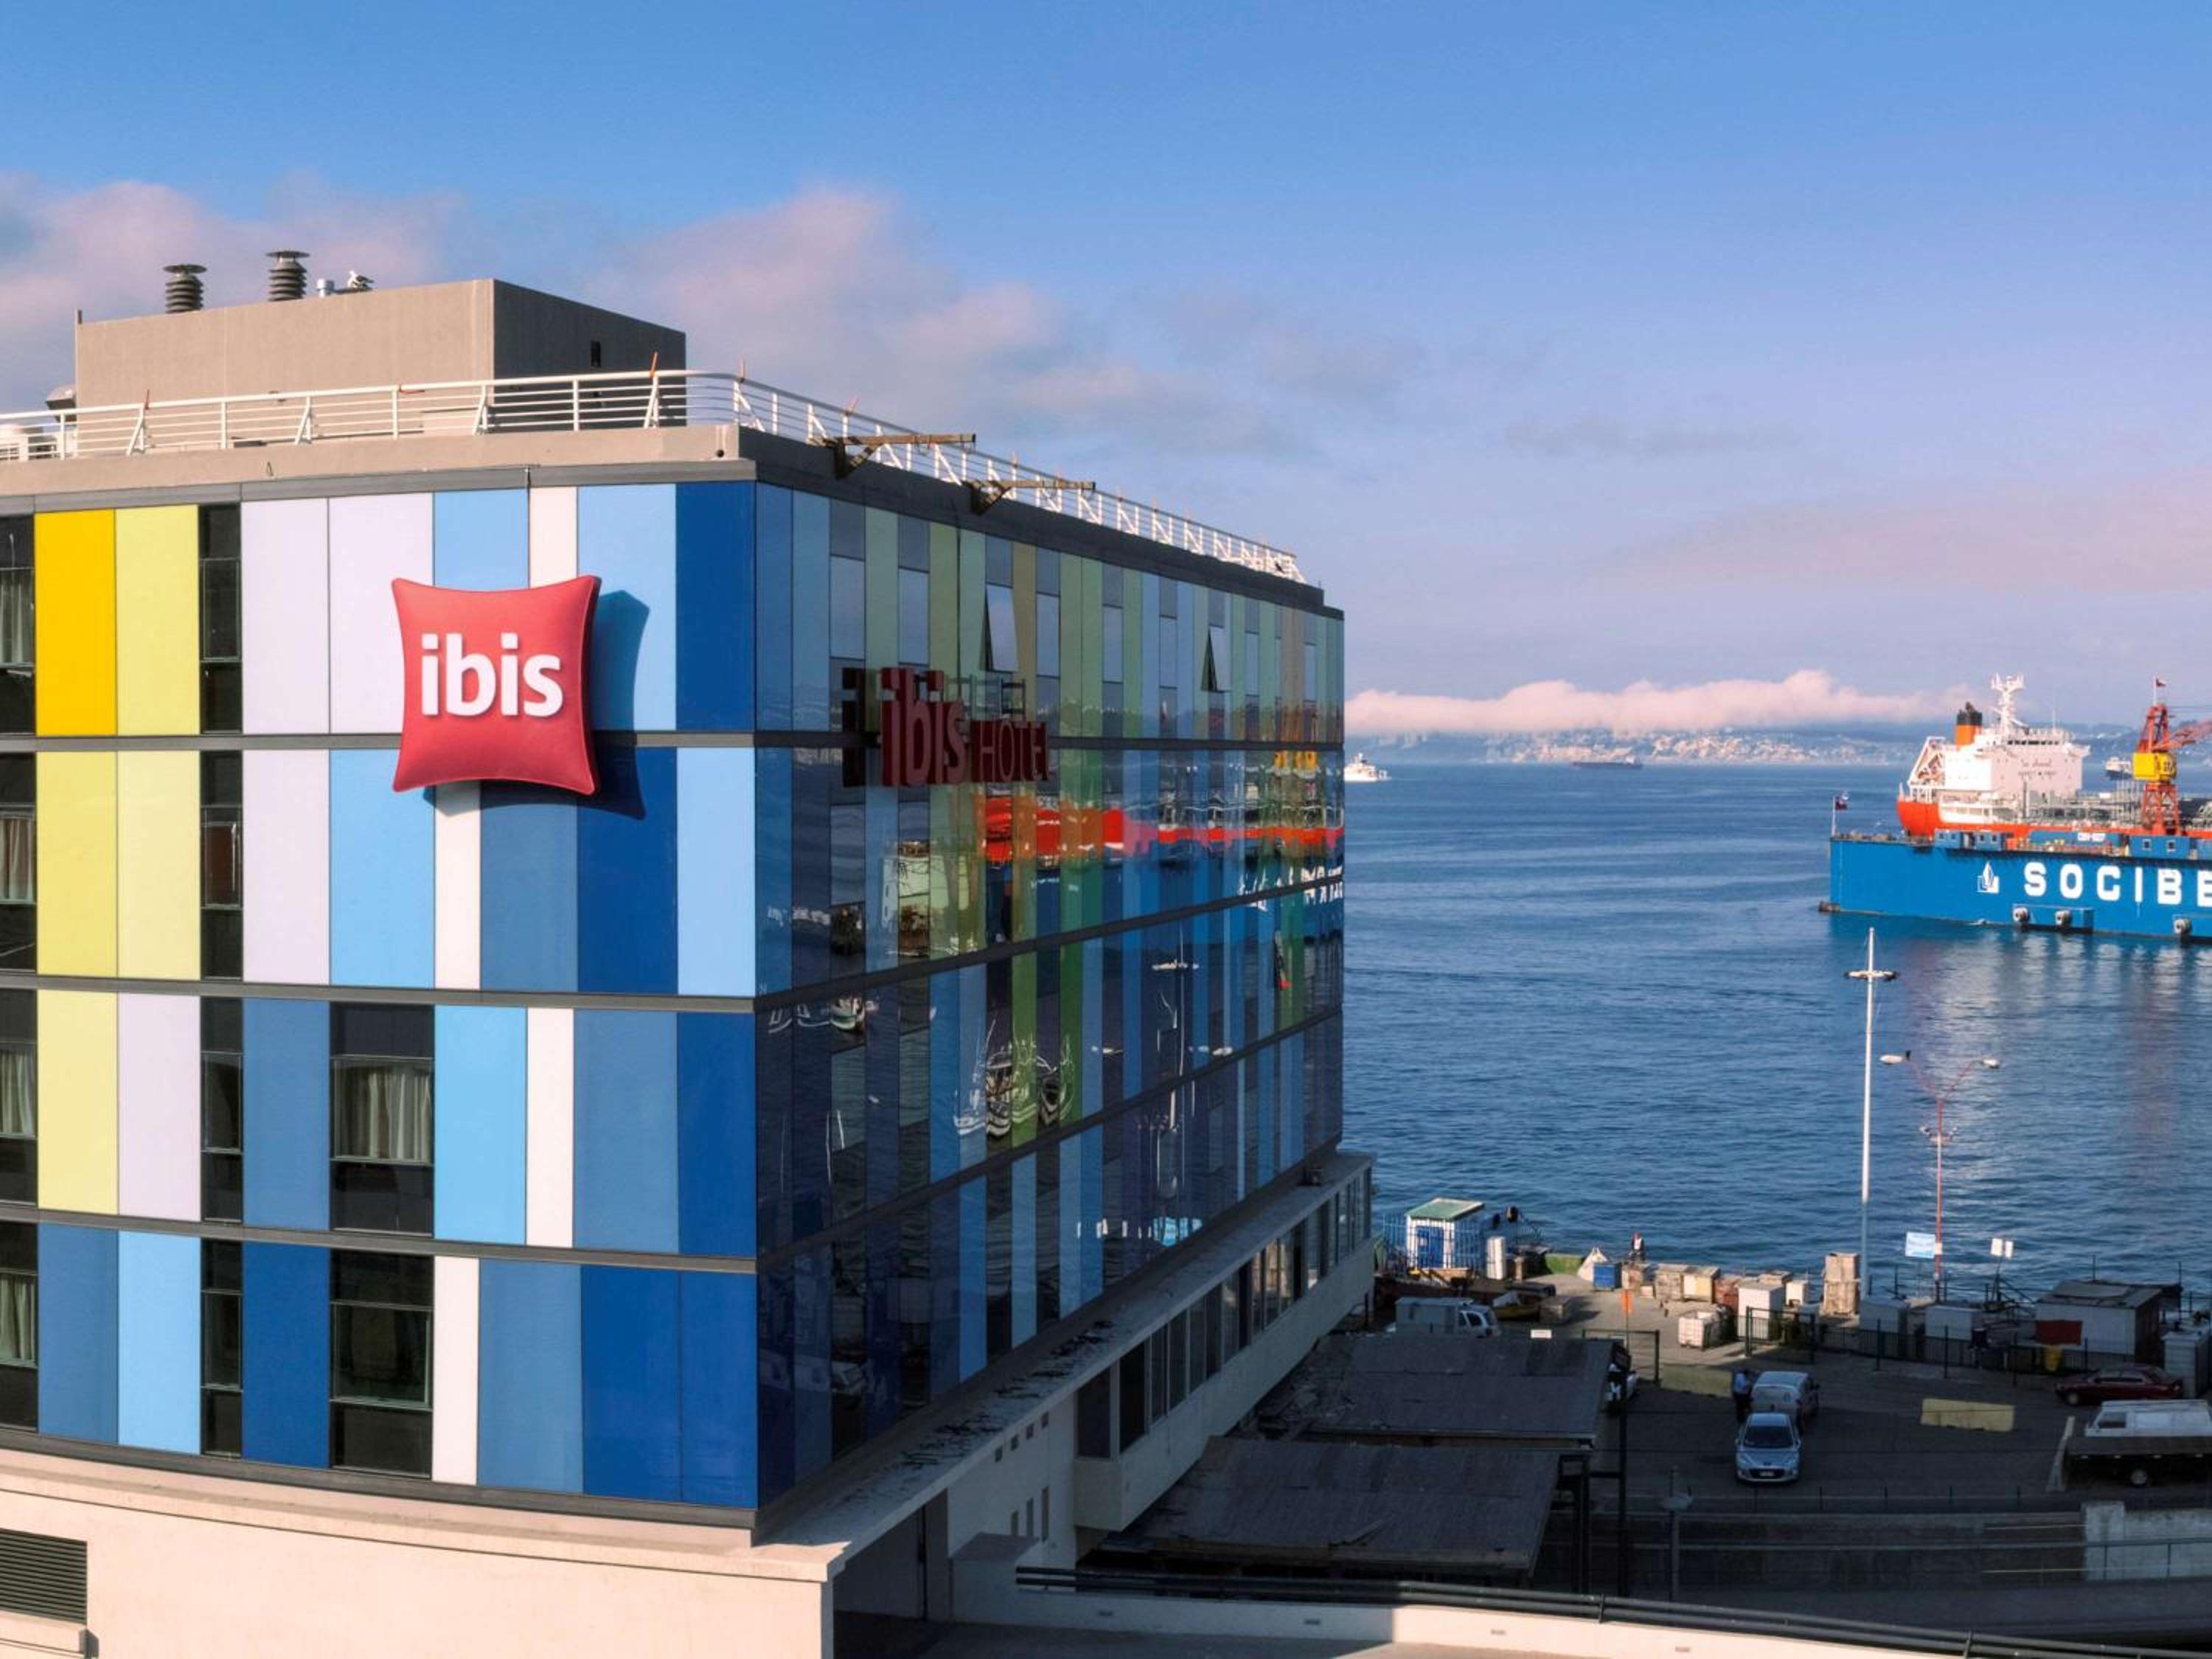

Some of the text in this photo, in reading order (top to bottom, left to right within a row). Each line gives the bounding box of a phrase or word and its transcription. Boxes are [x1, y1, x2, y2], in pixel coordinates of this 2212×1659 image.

[421, 633, 563, 717] ibis
[882, 667, 968, 787] ibis
[2024, 861, 2212, 908] SOCIBE
